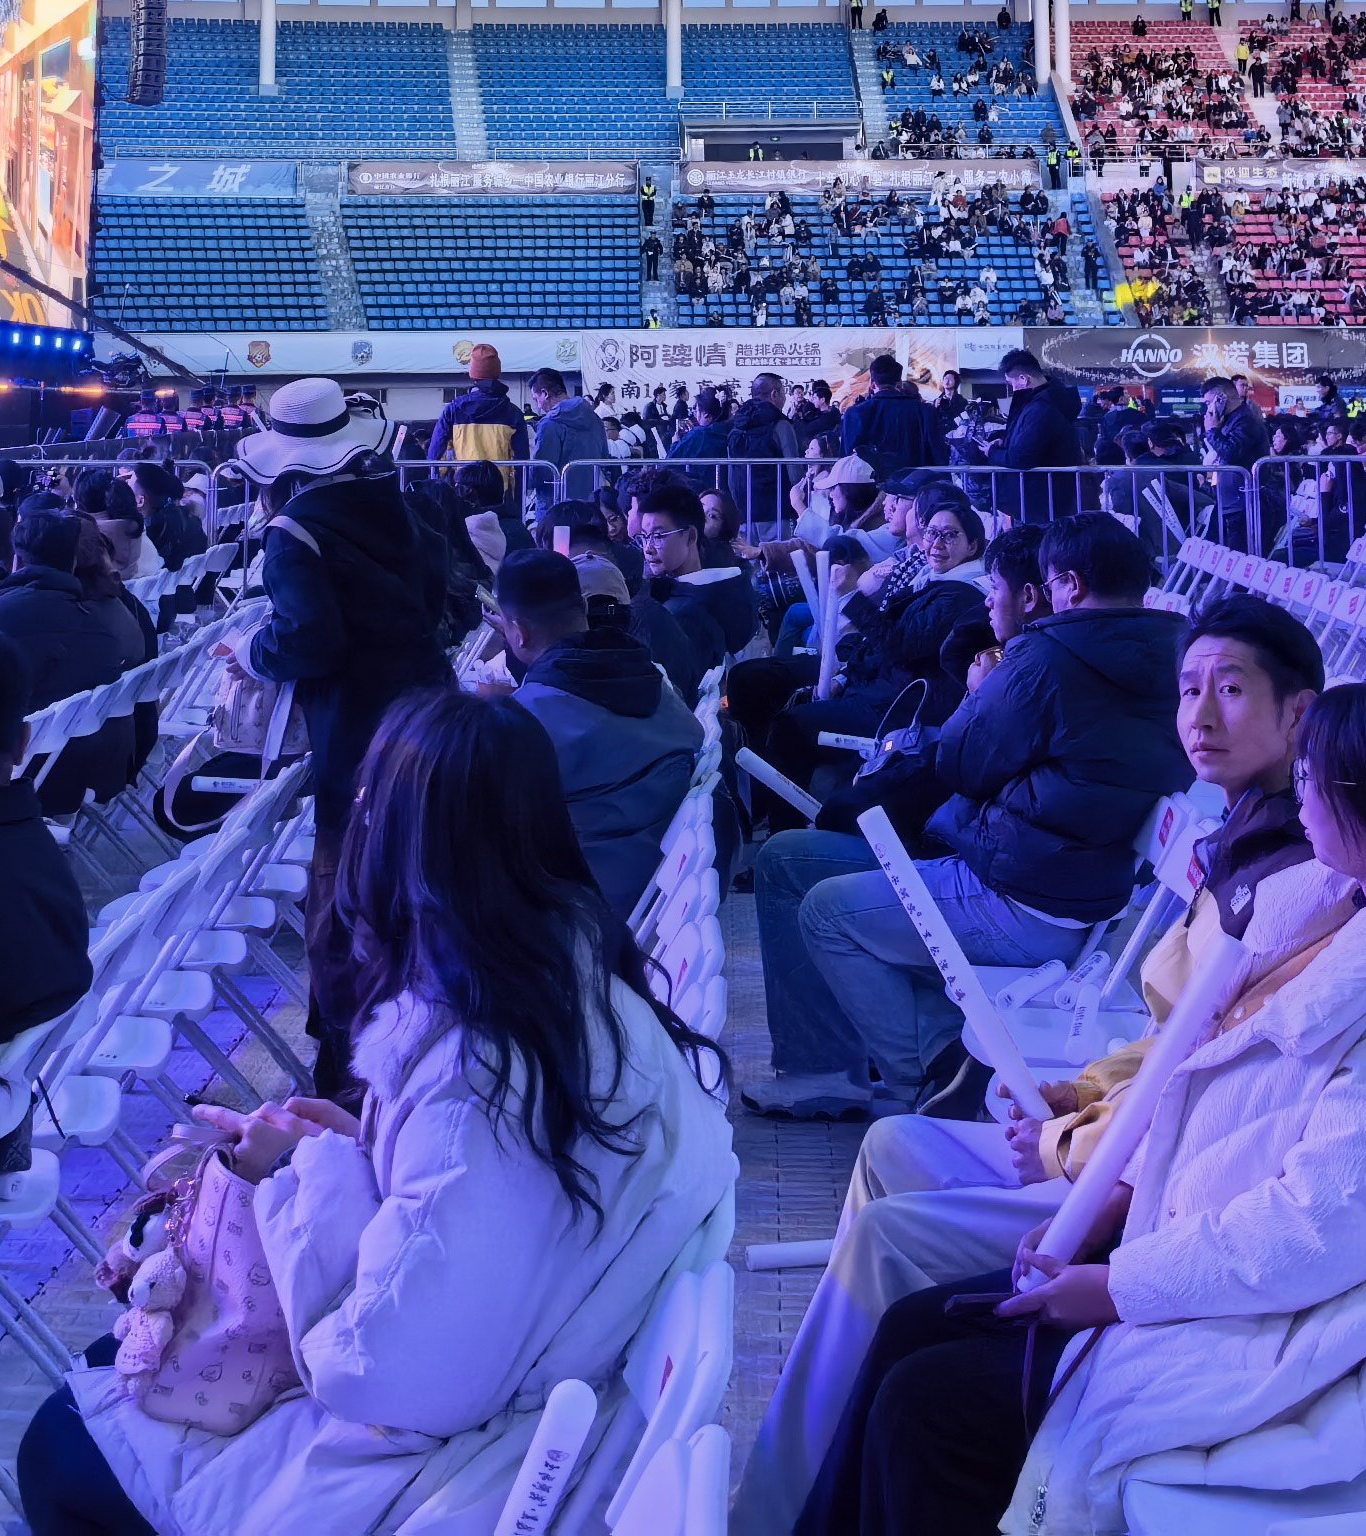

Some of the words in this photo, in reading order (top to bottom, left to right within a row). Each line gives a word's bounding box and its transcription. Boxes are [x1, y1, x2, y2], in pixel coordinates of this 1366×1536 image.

[628, 343, 728, 369] 阿婆情
[735, 342, 822, 357] 腊排骨火锅
[1119, 348, 1183, 363] HANNO
[1192, 340, 1310, 370] 汉诺集团
